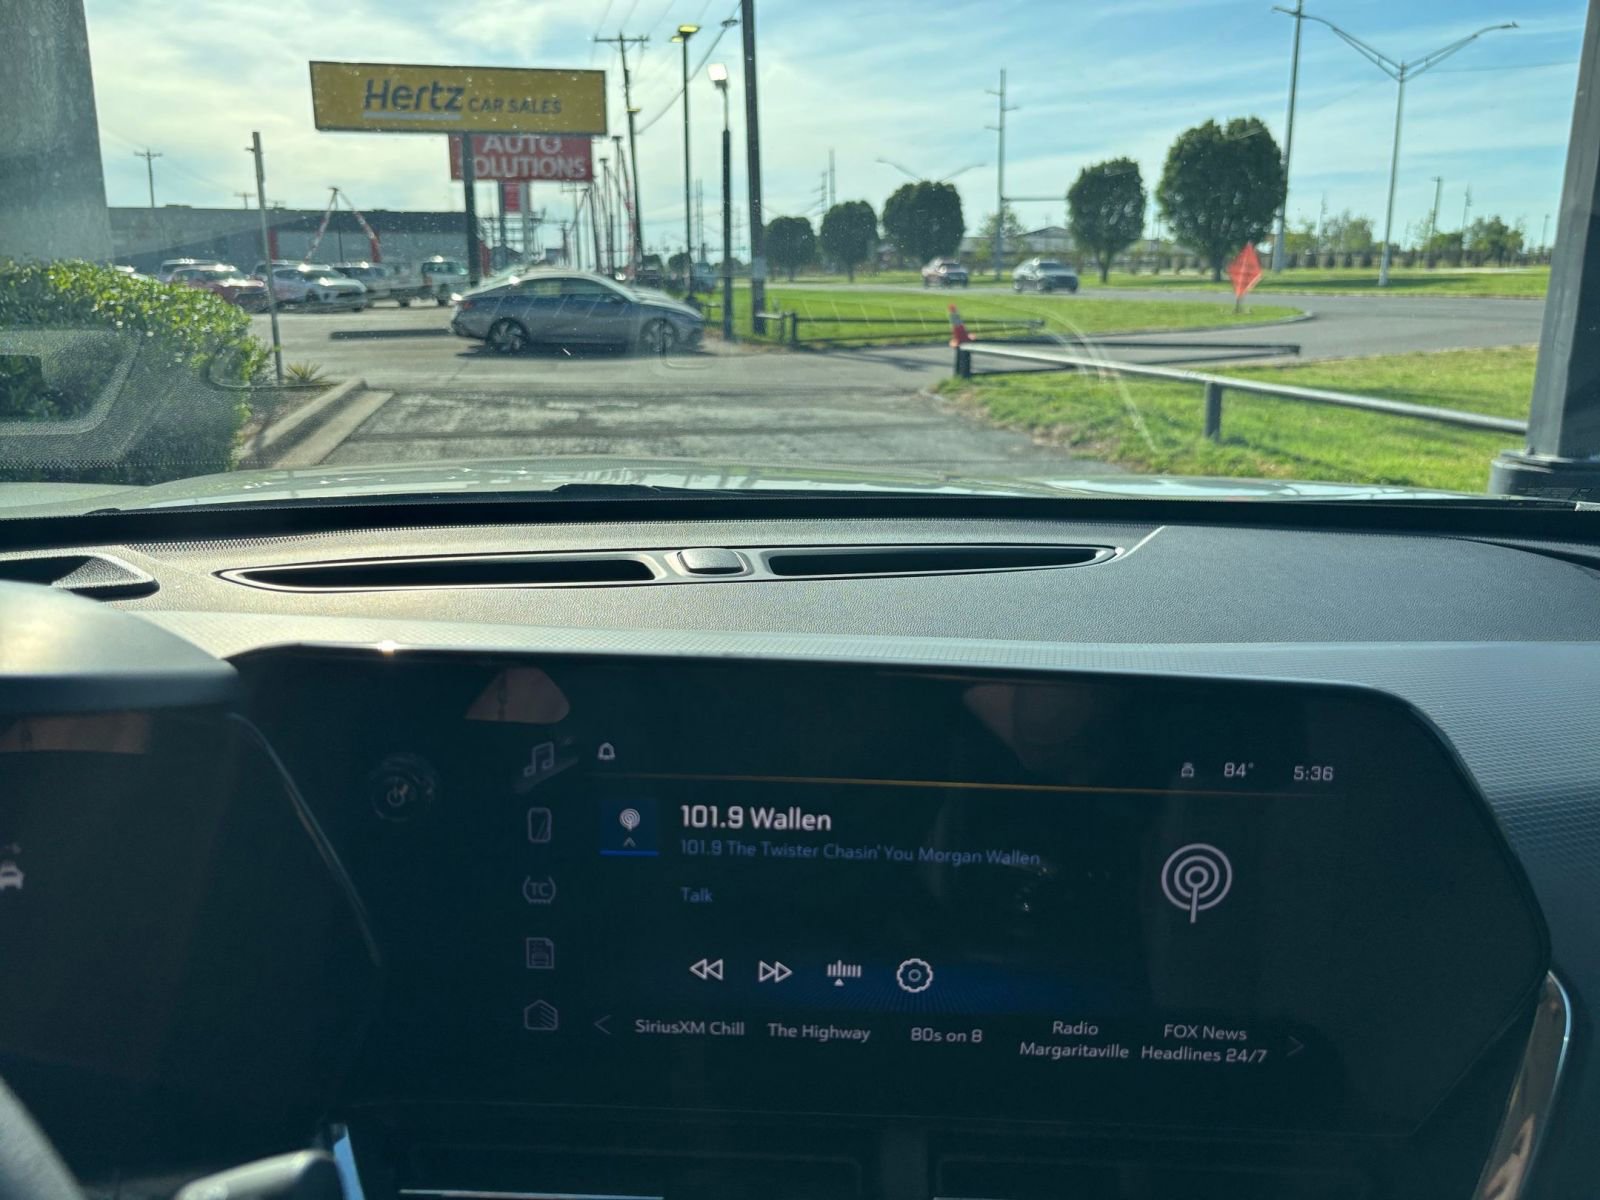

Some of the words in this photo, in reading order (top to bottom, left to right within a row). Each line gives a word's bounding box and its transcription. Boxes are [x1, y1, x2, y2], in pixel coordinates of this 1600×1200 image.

[363, 79, 464, 111] Hertz
[467, 97, 506, 113] CAR
[510, 97, 561, 114] SALES
[482, 135, 562, 154] AUTO
[458, 154, 587, 177] OLUTIONS
[1223, 762, 1254, 778] 84°
[1293, 765, 1334, 782] 5:36
[680, 804, 744, 829] 101.9
[749, 806, 833, 831] Wallen
[681, 839, 722, 855] 101.9
[726, 840, 757, 857] The
[761, 841, 818, 858] Twister
[823, 843, 881, 860] Chasin'
[884, 847, 914, 861] You
[918, 848, 982, 867] Morgan
[986, 850, 1041, 865] Wallen
[680, 886, 713, 903] Talk
[634, 1018, 705, 1035] SiriusXM
[710, 1021, 745, 1036] Chill
[767, 1022, 798, 1038] The
[802, 1024, 871, 1043] Highway
[910, 1027, 943, 1042] 80s
[946, 1031, 967, 1043] on
[971, 1029, 983, 1043] 8
[1052, 1020, 1099, 1036] Radio
[1163, 1023, 1199, 1039] FOX
[1202, 1025, 1248, 1041] News
[1019, 1041, 1130, 1060] Margaritaville
[1141, 1045, 1222, 1062] Headlines
[1225, 1047, 1268, 1063] 24/7
